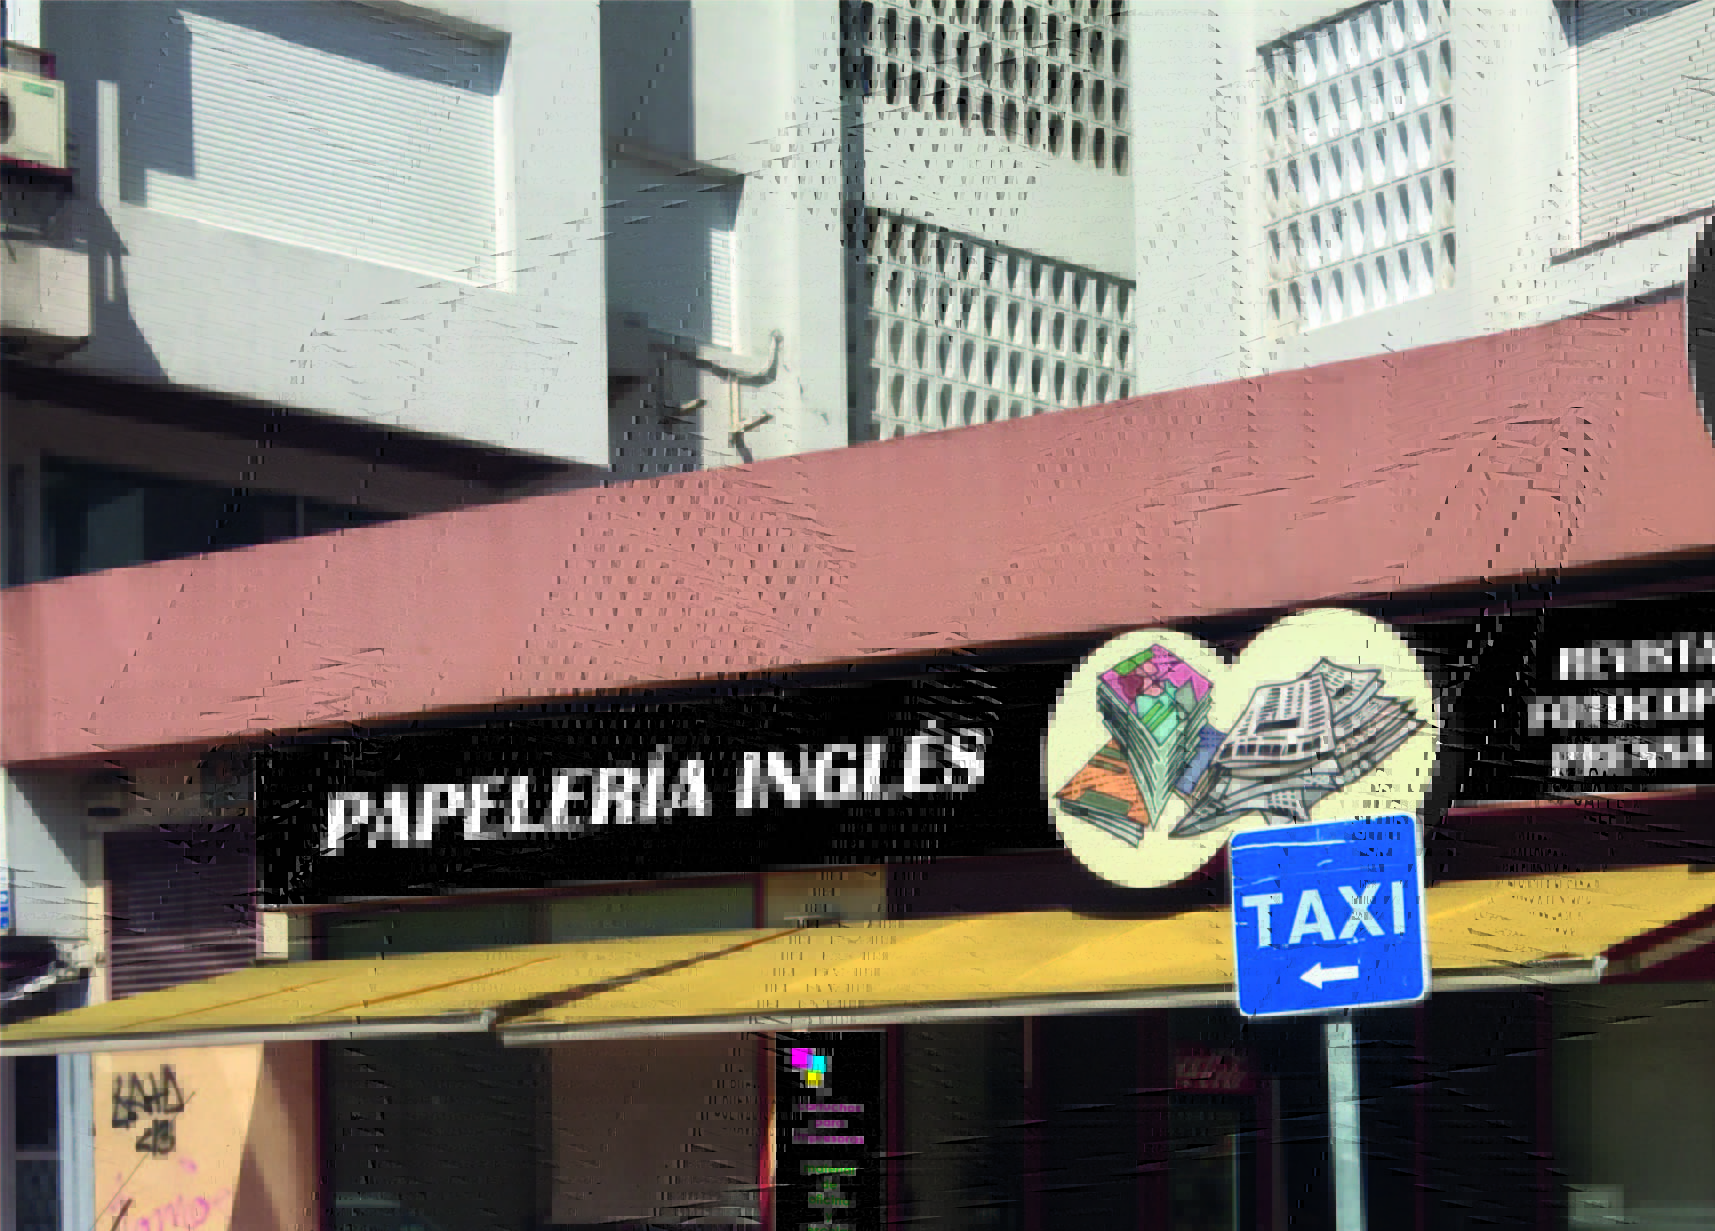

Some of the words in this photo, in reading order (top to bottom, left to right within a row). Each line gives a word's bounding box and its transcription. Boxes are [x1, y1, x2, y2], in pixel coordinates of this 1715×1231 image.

[323, 743, 712, 857] PAPELERÍA
[736, 719, 987, 811] INGLÉS
[1241, 879, 1407, 949] TAXI
[804, 1163, 857, 1177] material
[822, 1179, 838, 1191] de
[807, 1194, 851, 1208] oficina
